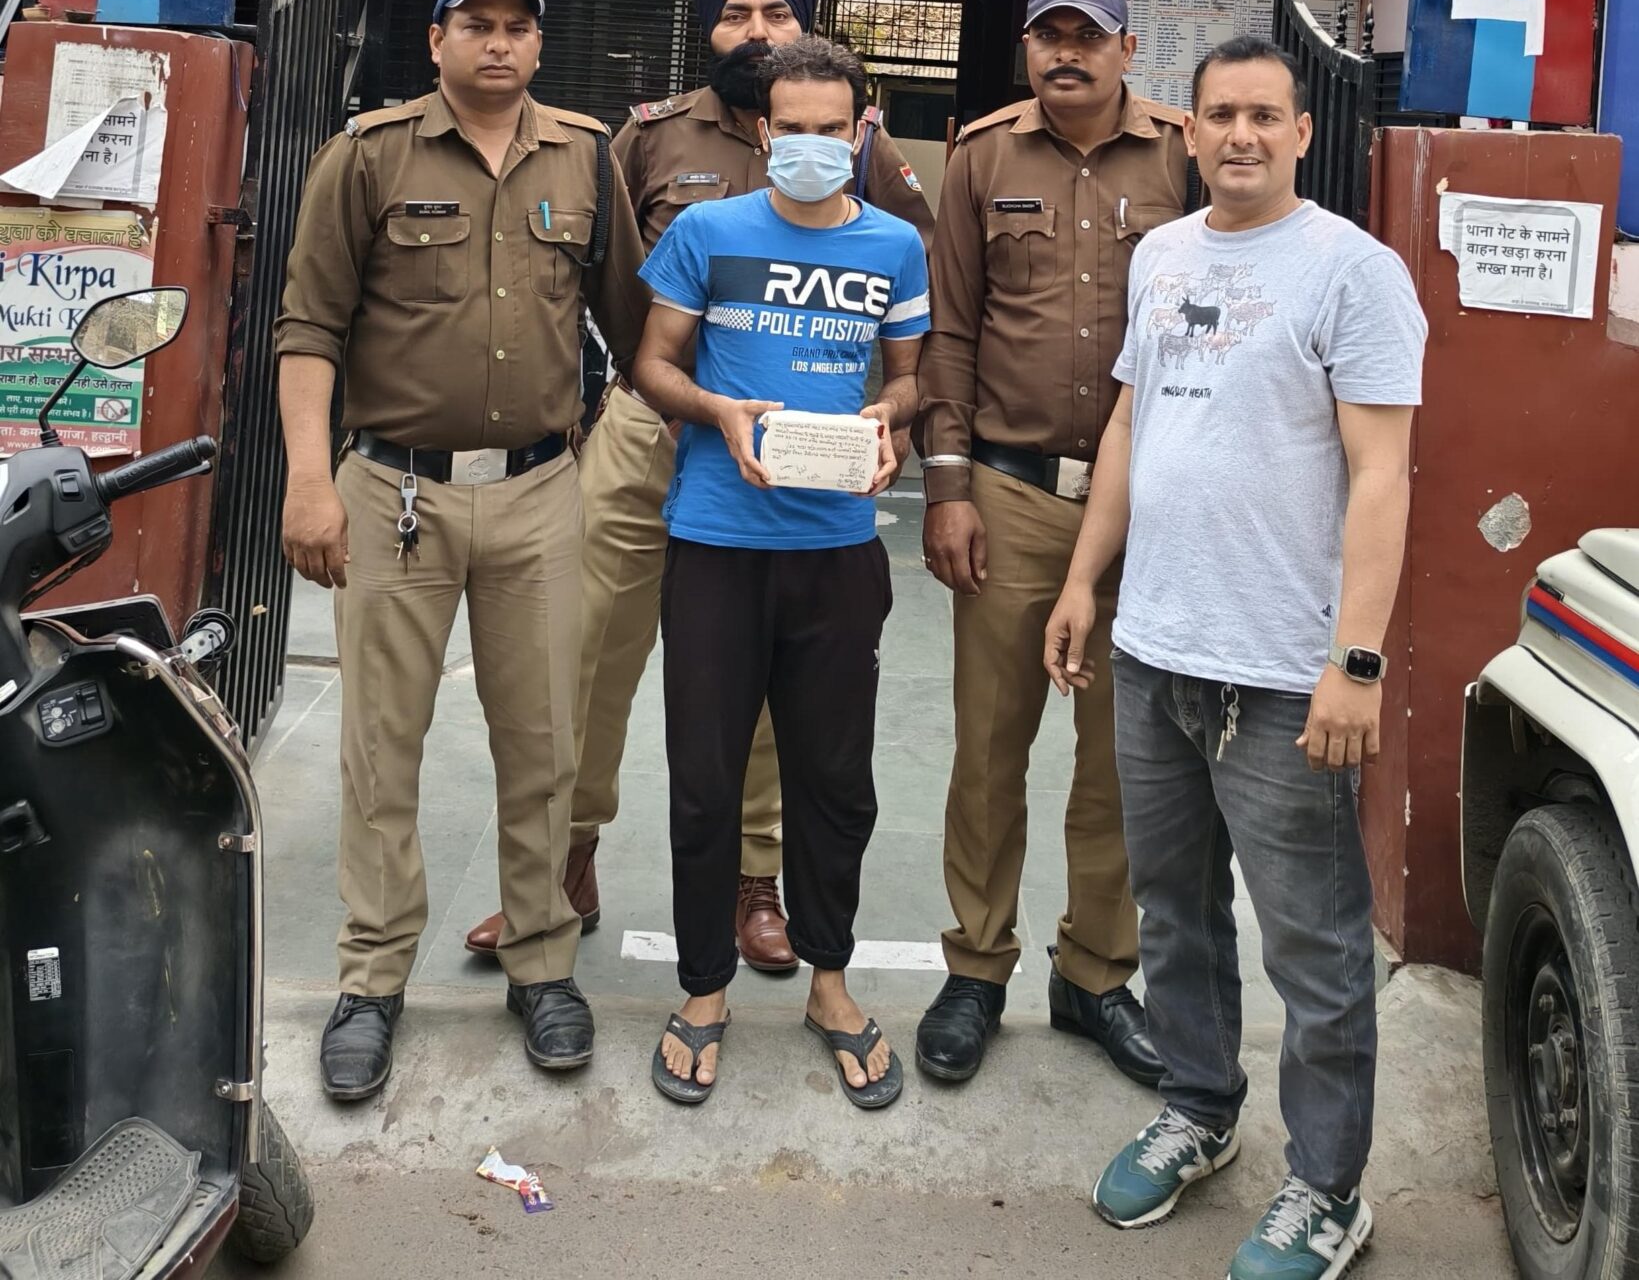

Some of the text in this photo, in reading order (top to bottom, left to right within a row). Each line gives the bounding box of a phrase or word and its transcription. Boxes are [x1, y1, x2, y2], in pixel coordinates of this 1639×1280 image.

[98, 132, 132, 147] करना
[36, 219, 62, 242] को
[1466, 223, 1571, 244] थाना गेट के सामने
[1466, 242, 1567, 262] वाहन खड़ा करना
[17, 252, 117, 300] Kirpa
[1476, 261, 1507, 276] सख्त
[1510, 264, 1535, 278] मना
[763, 263, 891, 317] RACE
[757, 310, 805, 338] POLE
[792, 347, 821, 359] GRAND
[791, 360, 809, 372] LOS
